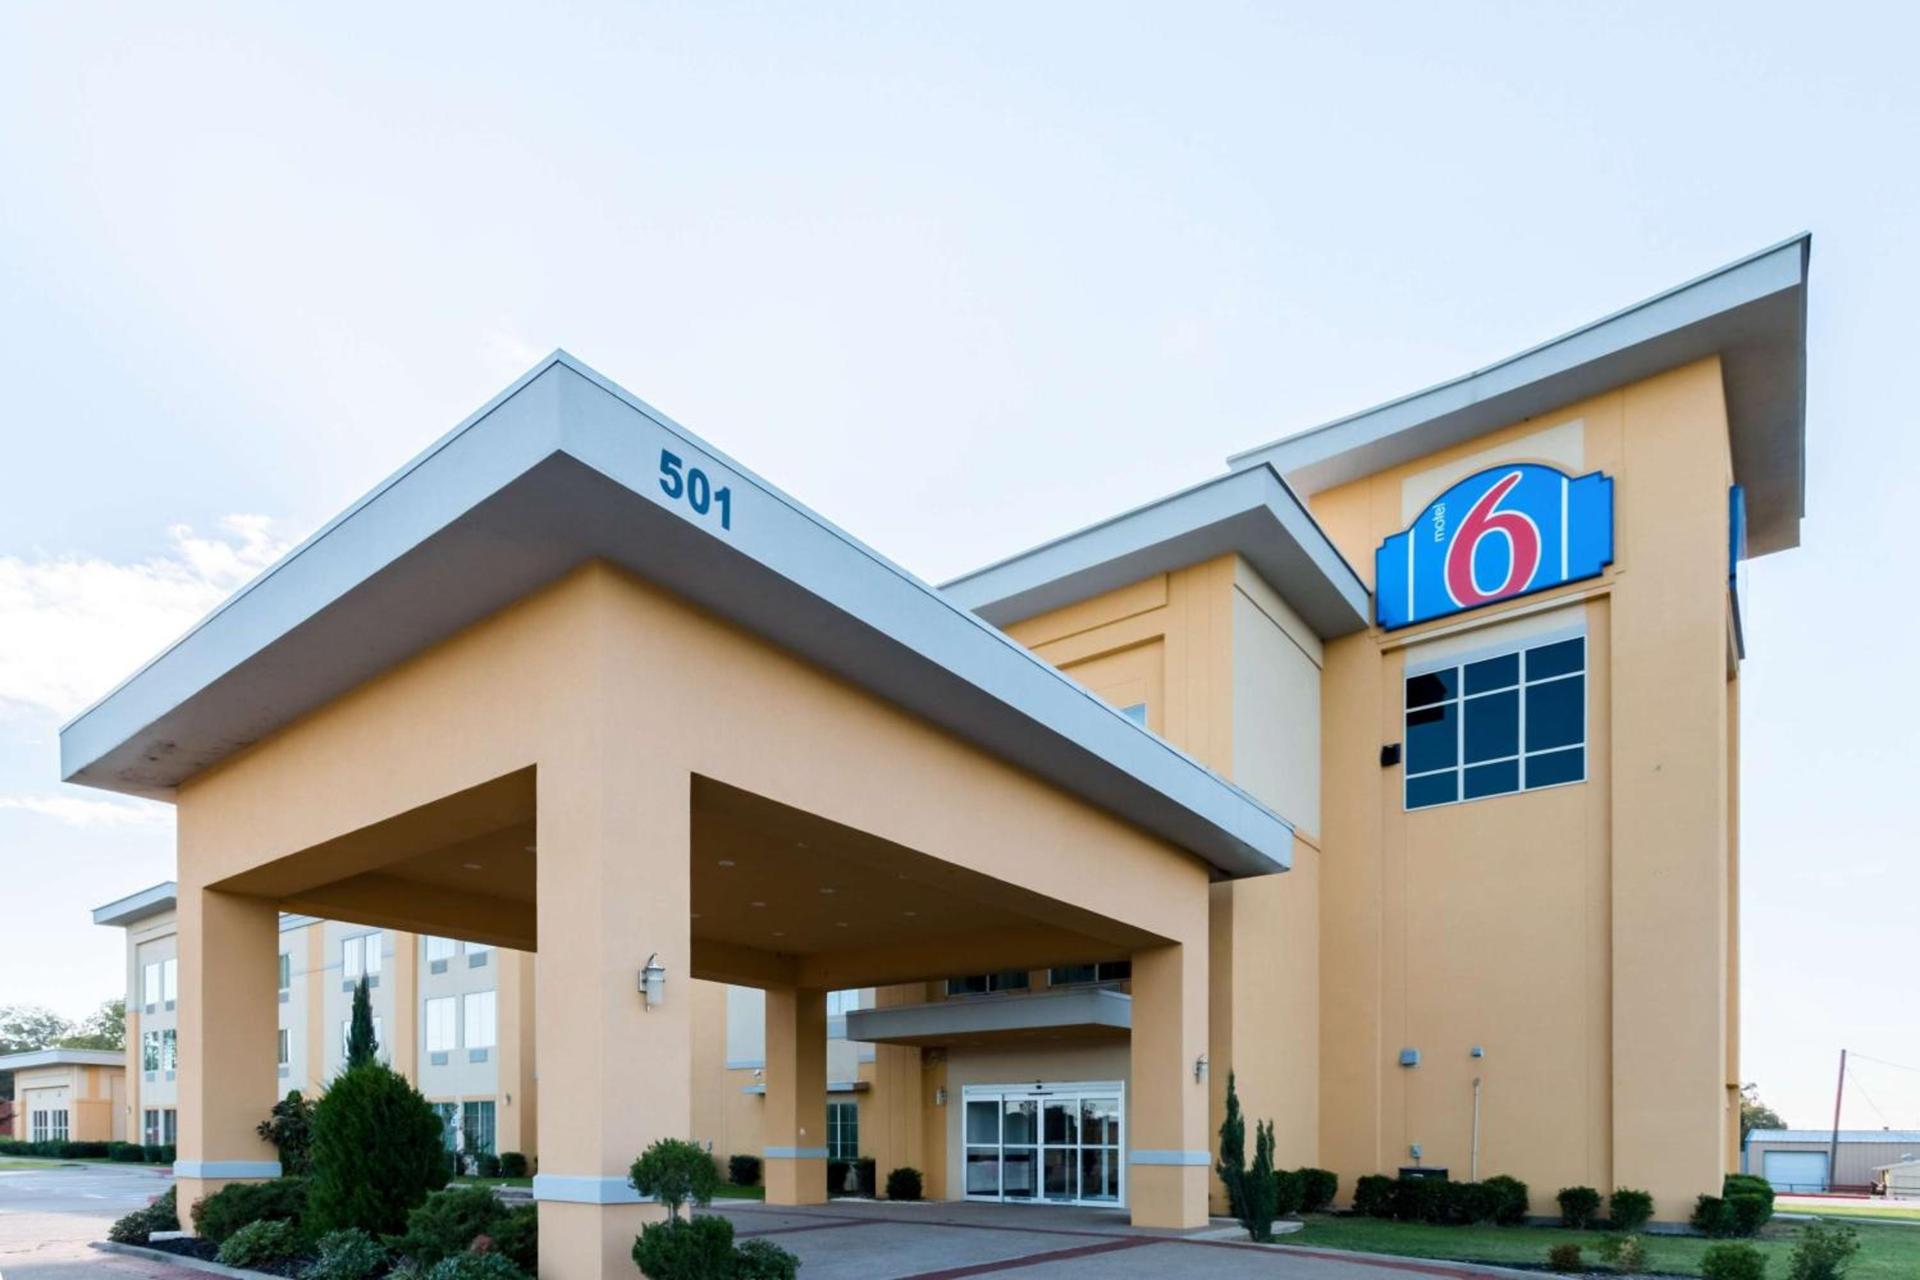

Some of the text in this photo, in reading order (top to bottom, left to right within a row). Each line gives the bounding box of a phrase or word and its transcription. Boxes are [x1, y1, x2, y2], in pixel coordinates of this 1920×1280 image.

[659, 448, 731, 531] 501
[1432, 471, 1542, 608] motel 6
